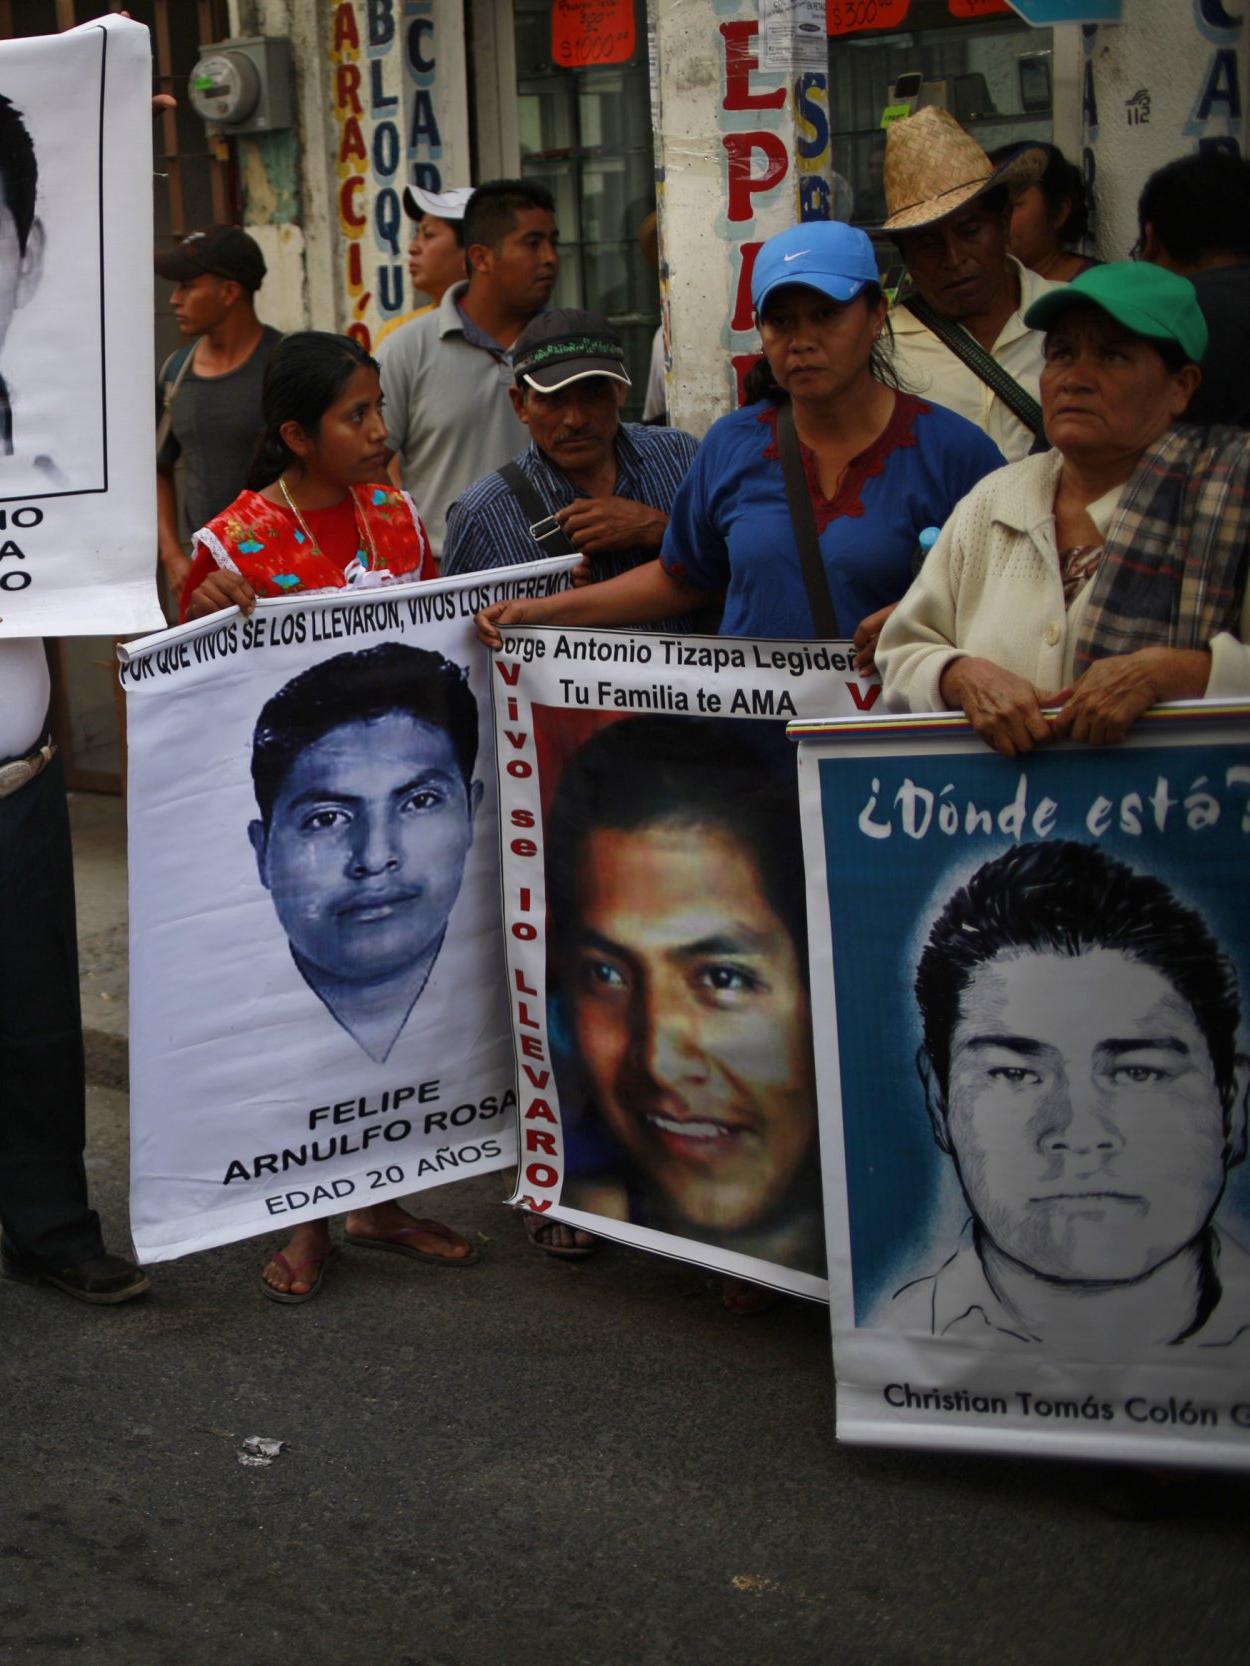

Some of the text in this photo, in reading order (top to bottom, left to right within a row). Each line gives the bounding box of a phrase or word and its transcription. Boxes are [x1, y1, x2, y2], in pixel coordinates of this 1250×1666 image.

[156, 644, 191, 675] QUE
[193, 621, 238, 663] VIVOS
[242, 618, 266, 650] SE
[270, 611, 306, 646] LOS
[311, 601, 405, 642] LLEVARON,
[408, 591, 456, 626] VIVOS
[459, 584, 491, 617] LOS
[495, 636, 546, 662] orge
[553, 634, 651, 664] Antonio
[659, 641, 745, 673] Tizapa
[559, 678, 798, 716] Tu Familia te AMA
[858, 772, 1058, 841] ¿Dónde
[309, 1079, 440, 1130] FELIPE
[222, 1089, 517, 1185] ARNULFO ROSA
[265, 1140, 502, 1215] EDAD 20 AÑOS
[883, 1383, 1007, 1414] Christian
[1015, 1391, 1114, 1421] Tomás
[1124, 1396, 1218, 1427] Colón
